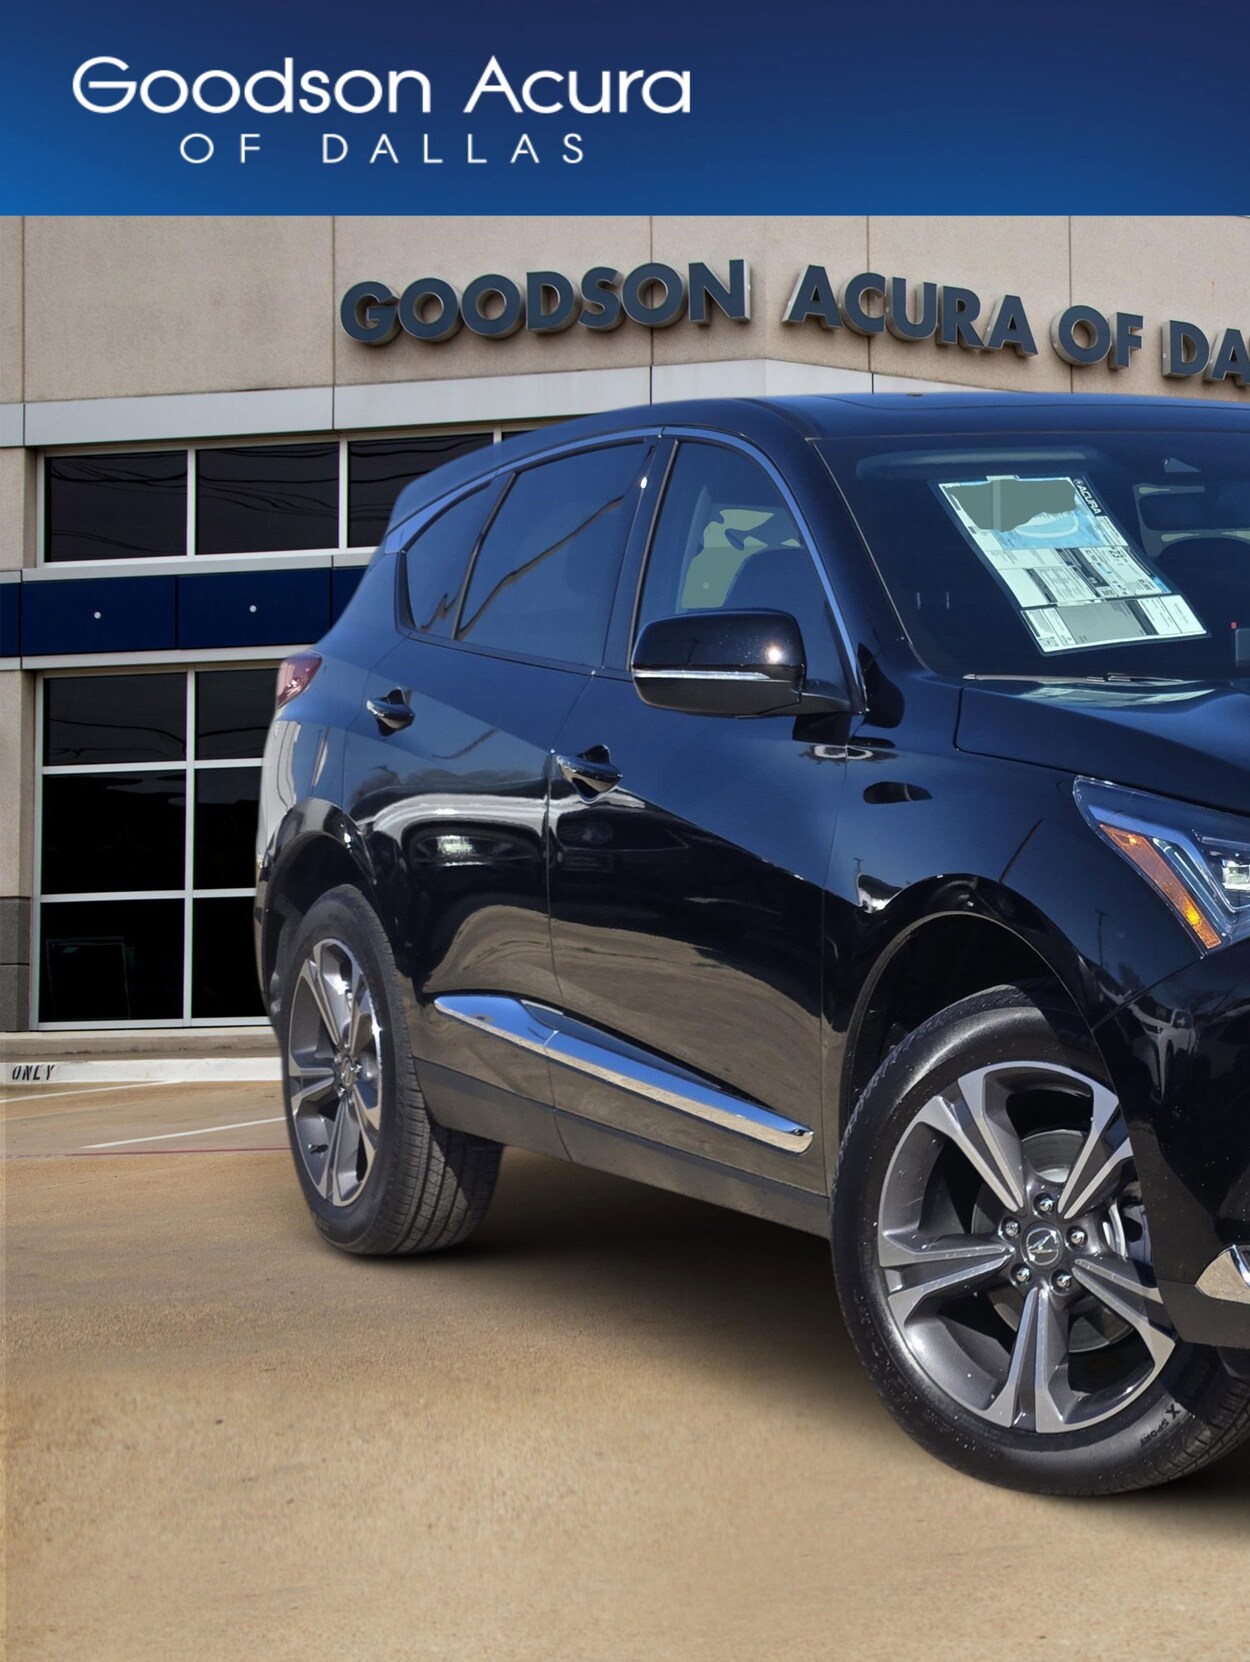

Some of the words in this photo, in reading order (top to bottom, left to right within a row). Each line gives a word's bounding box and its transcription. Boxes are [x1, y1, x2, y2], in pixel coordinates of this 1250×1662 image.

[339, 258, 751, 346] GOODSON
[782, 264, 1038, 358] ACURA
[1051, 304, 1144, 370] OF
[1077, 484, 1102, 515] ACURA
[11, 1064, 55, 1081] ONLY
